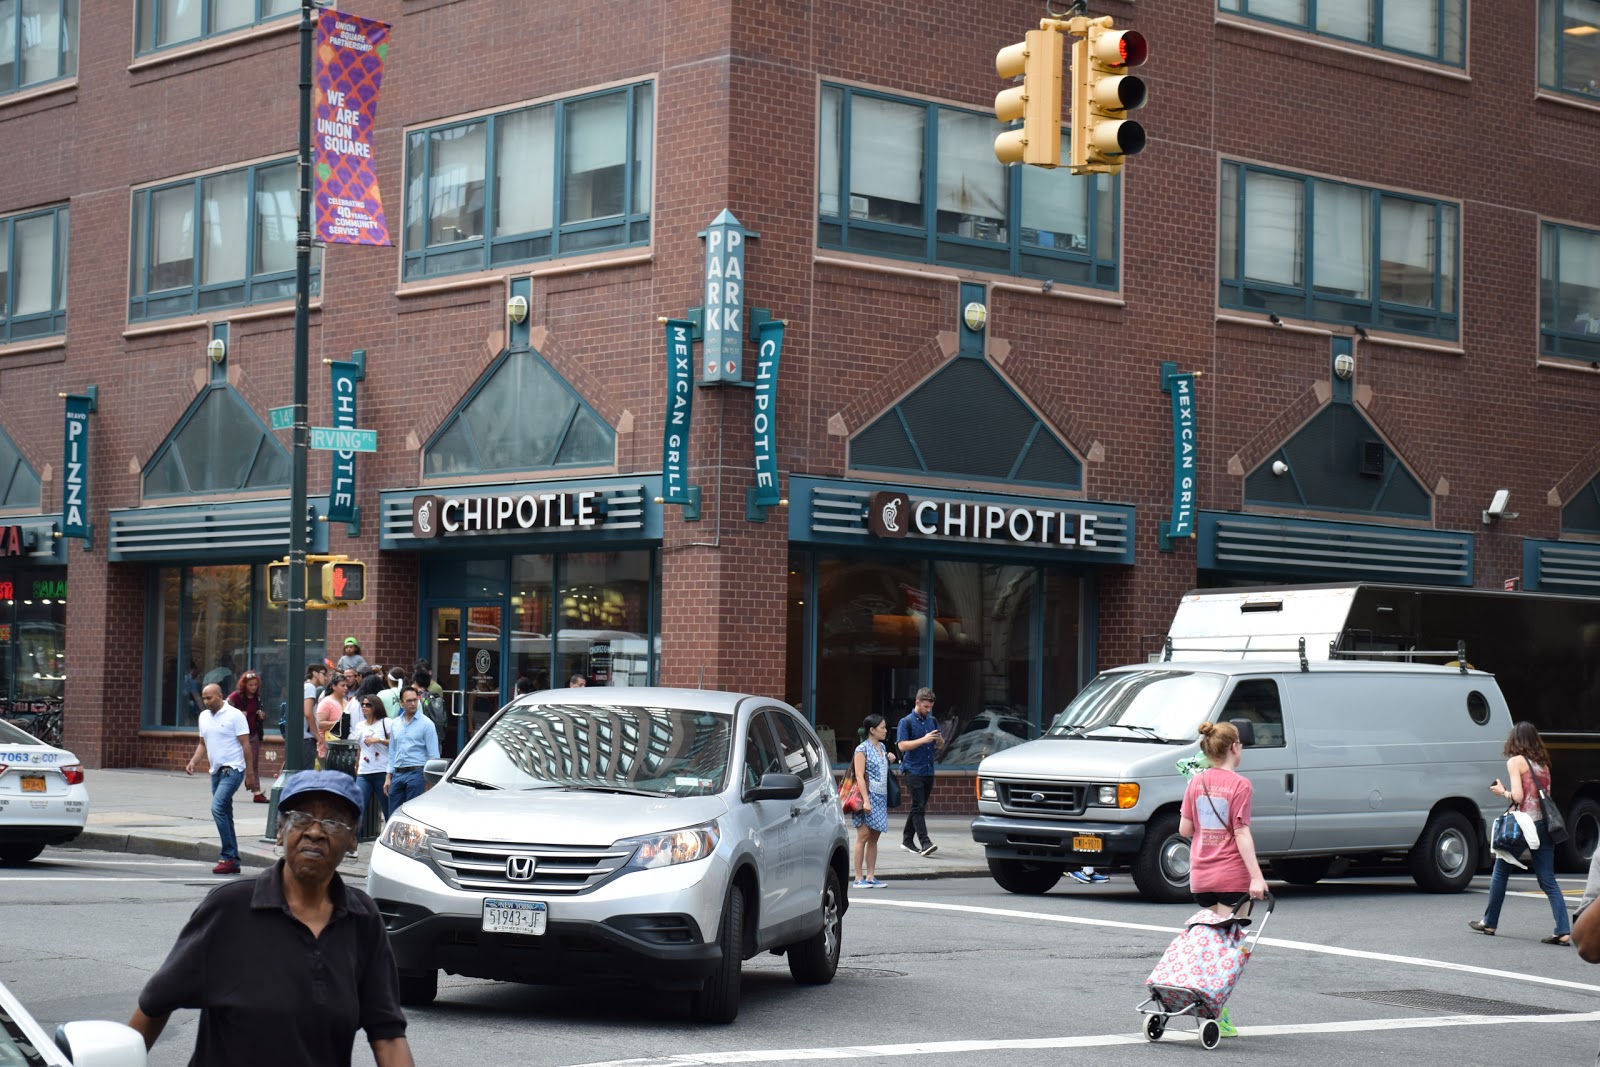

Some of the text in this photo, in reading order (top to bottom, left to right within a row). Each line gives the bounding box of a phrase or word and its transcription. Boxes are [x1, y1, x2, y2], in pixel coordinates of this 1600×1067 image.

[335, 21, 356, 32] UNION
[329, 36, 373, 52] PARTNERSHIP
[340, 31, 366, 43] SQUARE
[327, 89, 345, 108] WE
[336, 108, 360, 126] ARE
[317, 117, 352, 139] UNION
[324, 135, 371, 158] SQUARE
[328, 197, 365, 209] CELEBRATING
[337, 206, 351, 218] 40
[328, 225, 360, 236] SERVICE
[335, 218, 378, 229] COMMUNITY
[707, 230, 722, 332] PARK
[724, 229, 742, 332] PARK
[66, 411, 87, 420] BRAVO
[271, 411, 279, 428] E
[668, 327, 689, 497] MEXICAN GRILL
[754, 339, 776, 488] CHIPOTLE
[311, 430, 374, 449] IRVING PL
[1177, 380, 1193, 532] MEXICAN GRILL
[66, 421, 83, 526] PIZZA
[442, 492, 596, 531] CHIPOTLE
[915, 500, 1098, 546] CHIPOTLE
[32, 580, 68, 598] SALA
